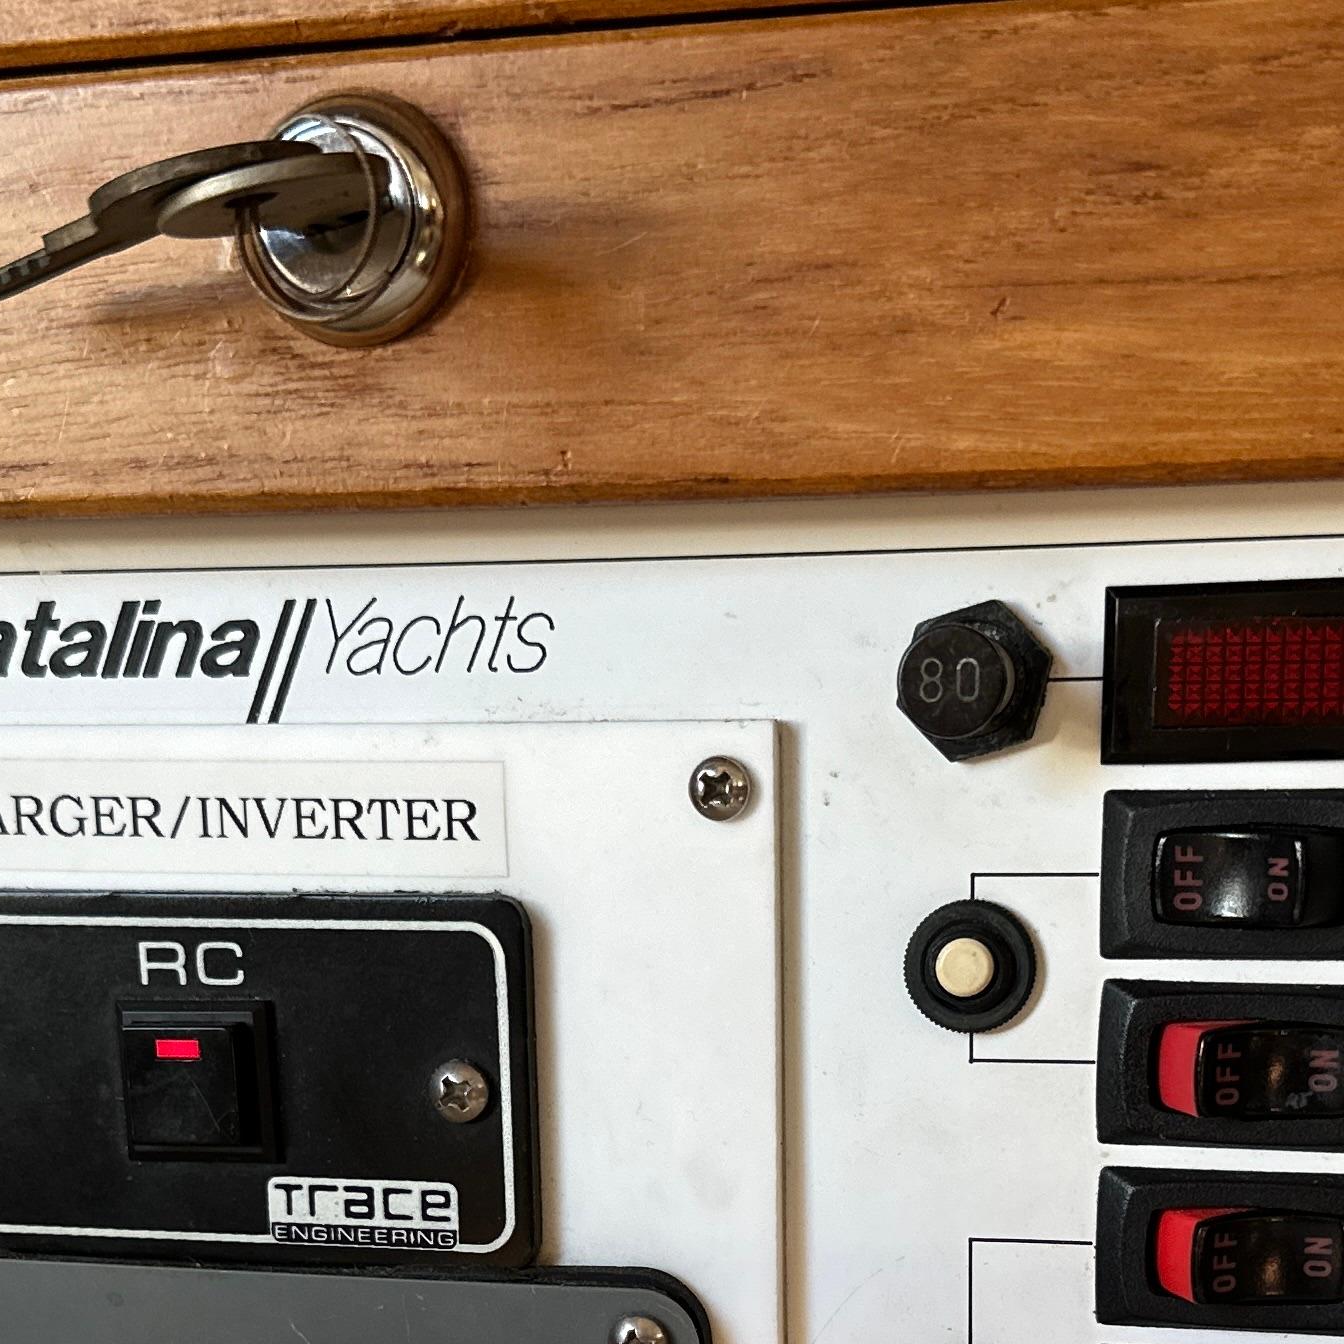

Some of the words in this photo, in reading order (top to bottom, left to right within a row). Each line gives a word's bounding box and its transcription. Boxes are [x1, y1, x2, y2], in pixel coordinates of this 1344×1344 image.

[323, 595, 555, 676] Yachts
[918, 657, 981, 704] 80
[1173, 844, 1203, 910] OFF
[1267, 856, 1291, 902] ON
[138, 941, 244, 986] RC
[1215, 1042, 1243, 1107] OFF
[1309, 1050, 1339, 1092] ON
[274, 1224, 454, 1247] ENGINEERING
[1212, 1233, 1239, 1293] OFF
[1302, 1235, 1335, 1278] ON
